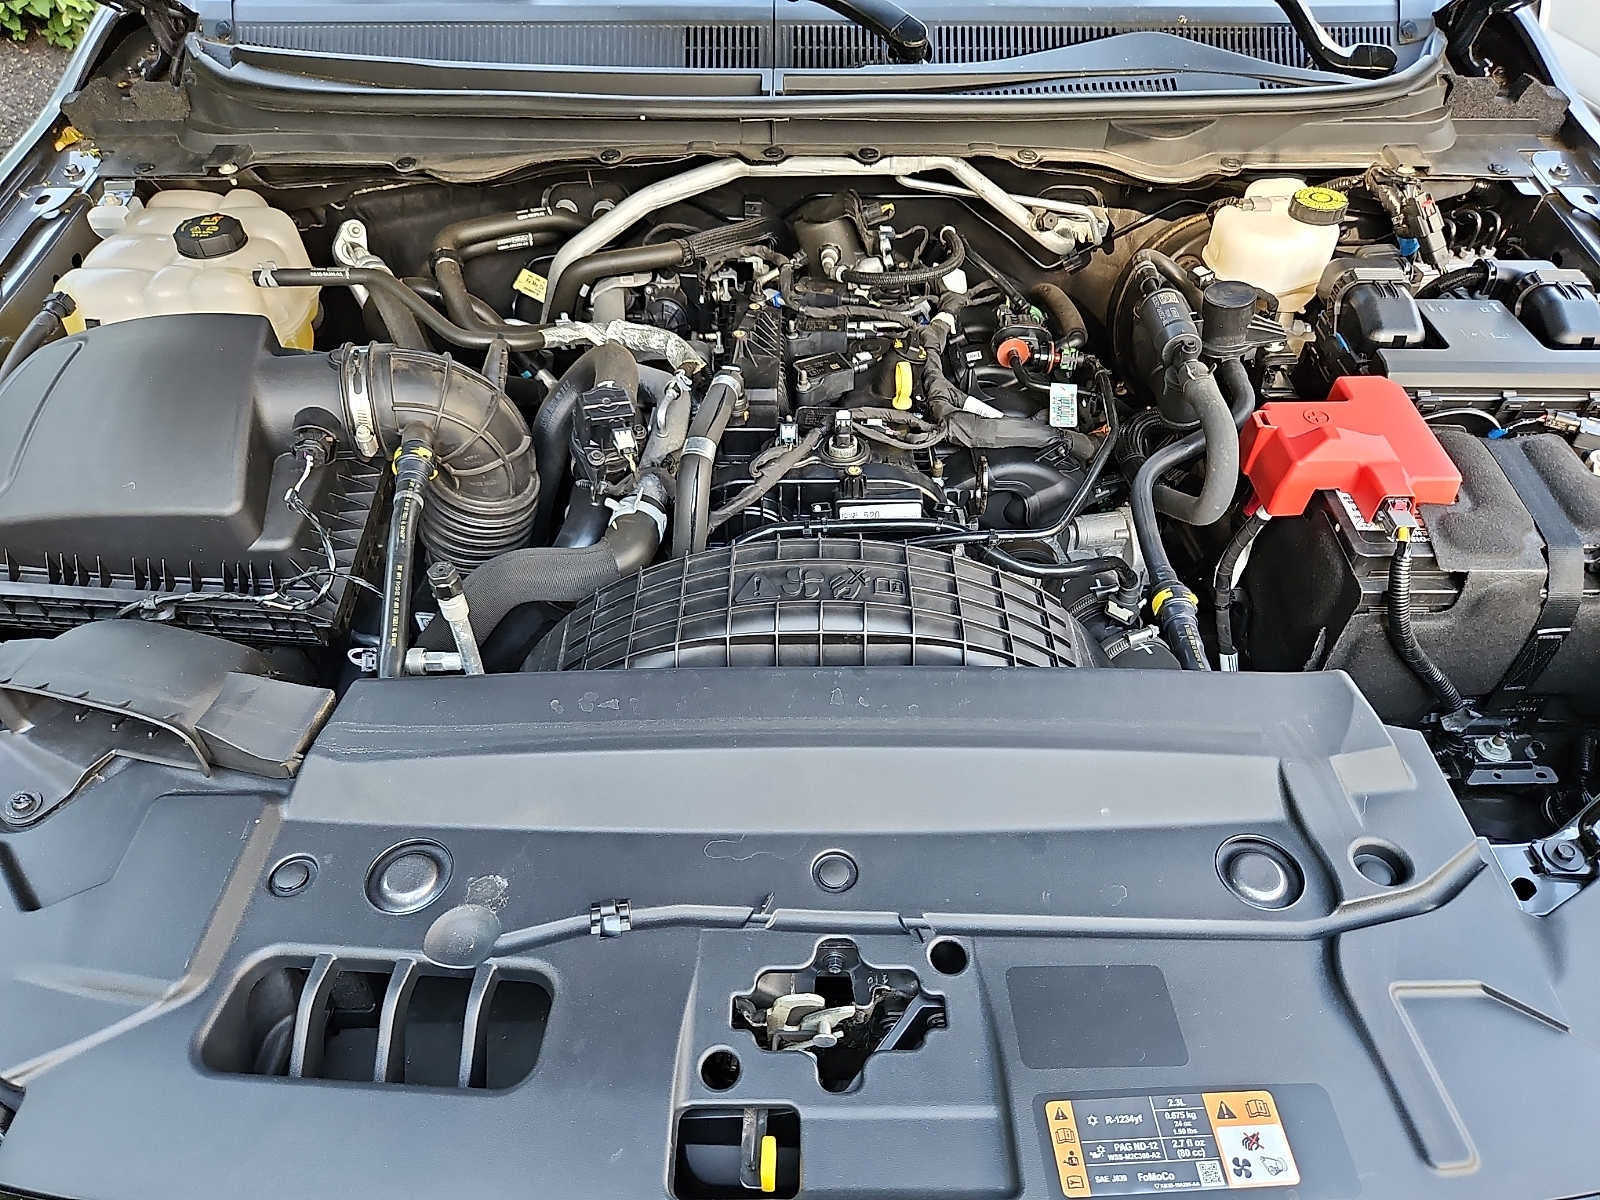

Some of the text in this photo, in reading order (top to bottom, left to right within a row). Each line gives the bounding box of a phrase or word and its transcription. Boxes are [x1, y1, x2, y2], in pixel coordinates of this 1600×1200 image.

[1167, 1098, 1187, 1107] 2.3L
[1105, 1113, 1143, 1125] R-1234yf
[1186, 1110, 1197, 1120] kg
[1113, 1142, 1132, 1152] PAG
[1171, 1139, 1185, 1148] 2.7
[1194, 1139, 1206, 1147] oz
[1137, 1171, 1175, 1182] FoMoCo
